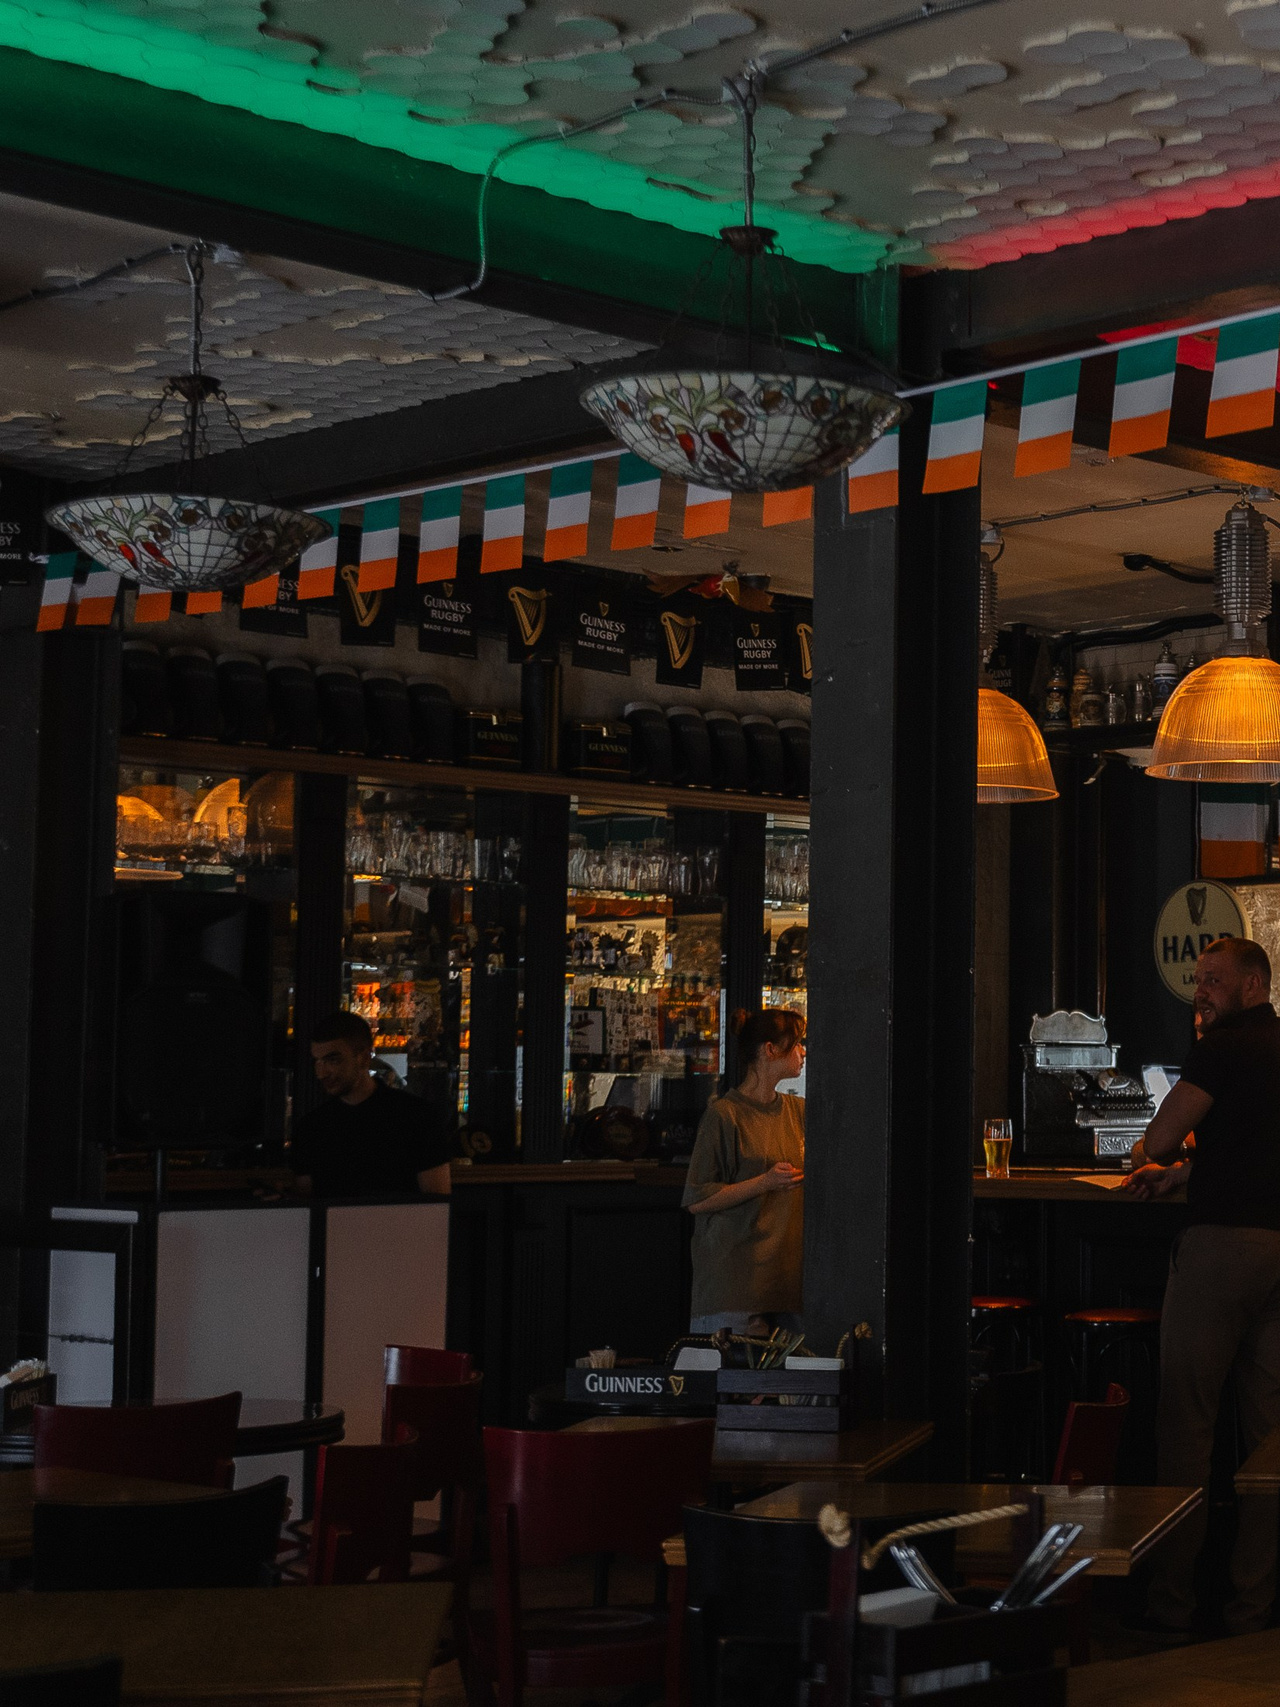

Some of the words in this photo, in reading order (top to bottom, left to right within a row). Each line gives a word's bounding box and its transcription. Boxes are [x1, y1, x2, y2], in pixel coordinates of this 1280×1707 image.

[424, 594, 472, 614] GUINNESS
[431, 609, 465, 623] RUGBY
[579, 612, 626, 633] GUINNESS
[423, 623, 442, 632] MADE
[452, 628, 472, 636] MORE
[585, 627, 619, 641] RUGBY
[577, 639, 596, 649] MADE
[606, 645, 625, 654] MORE
[736, 637, 777, 649] GUINNESS
[743, 649, 772, 659] RUGBY
[476, 731, 520, 743] GUINNESS
[588, 742, 631, 754] GUINNESS
[585, 1373, 664, 1394] GUINNESS
